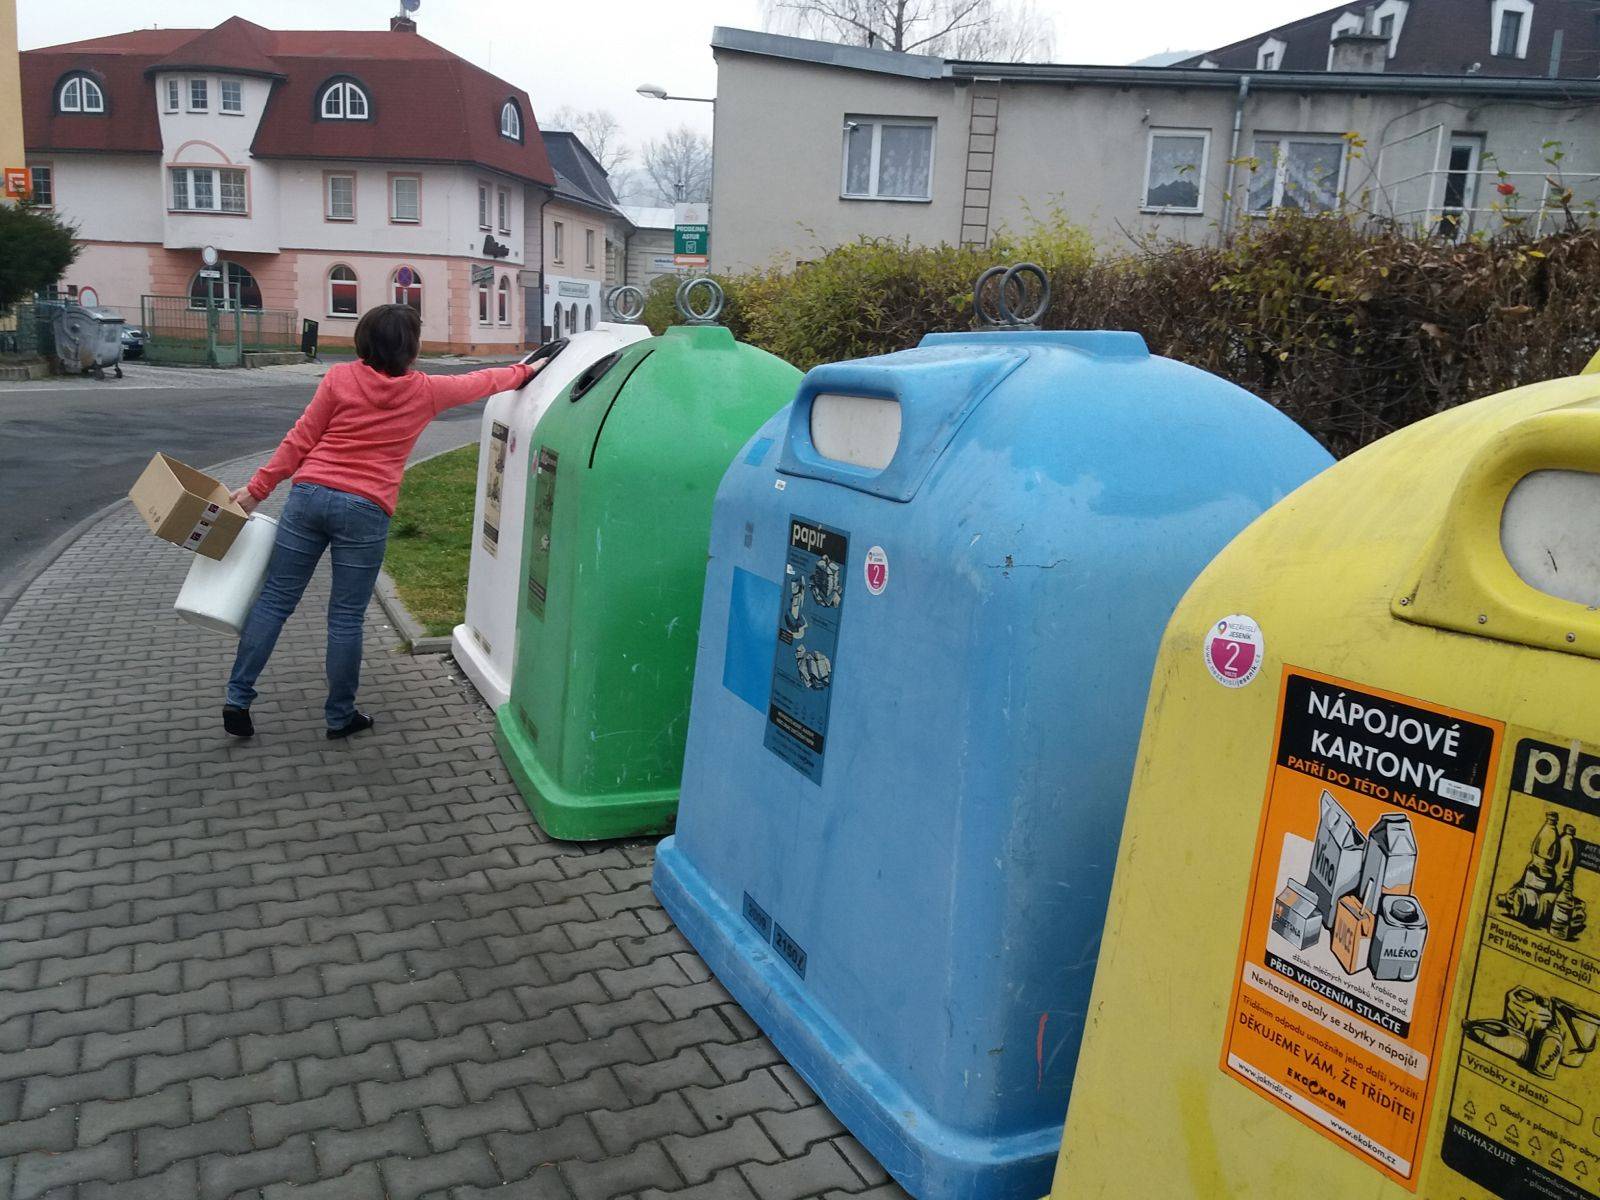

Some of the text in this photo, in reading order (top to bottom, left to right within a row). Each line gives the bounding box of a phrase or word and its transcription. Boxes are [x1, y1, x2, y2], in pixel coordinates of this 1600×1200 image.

[791, 523, 826, 551] papír
[873, 565, 880, 584] 2
[1224, 642, 1240, 672] 2
[1307, 690, 1461, 757] NÁPOJOVÉ
[1310, 729, 1445, 792] KARTONY
[1287, 755, 1465, 825] PATŘÍ DO TÉTO NÁDOBY
[1383, 946, 1418, 958] MLÉKO
[1488, 933, 1504, 946] PET
[1505, 939, 1532, 958] láhve
[1490, 922, 1529, 945] Plastové
[1531, 941, 1568, 964] nádoby
[1269, 957, 1402, 1034] PŘED VHOZENÍM STLAČTE
[1370, 981, 1409, 1006] Krabice od
[1251, 970, 1418, 1069] Nevhazujte obaly se zbytky nápojů!
[1239, 1012, 1301, 1057] DĚKUJEME
[1303, 1049, 1337, 1080] VÁM,
[1341, 1068, 1358, 1091] ŽE
[1361, 1081, 1416, 1124] TŘÍDÍTE!
[1345, 1052, 1364, 1070] jeho
[1467, 1054, 1507, 1084] Výrobky
[1510, 1080, 1516, 1088] z
[1500, 1103, 1526, 1123] Obaly
[1330, 1119, 1397, 1165] www.ekokom.cz
[1453, 1124, 1517, 1166] NEVHAZUJTE
